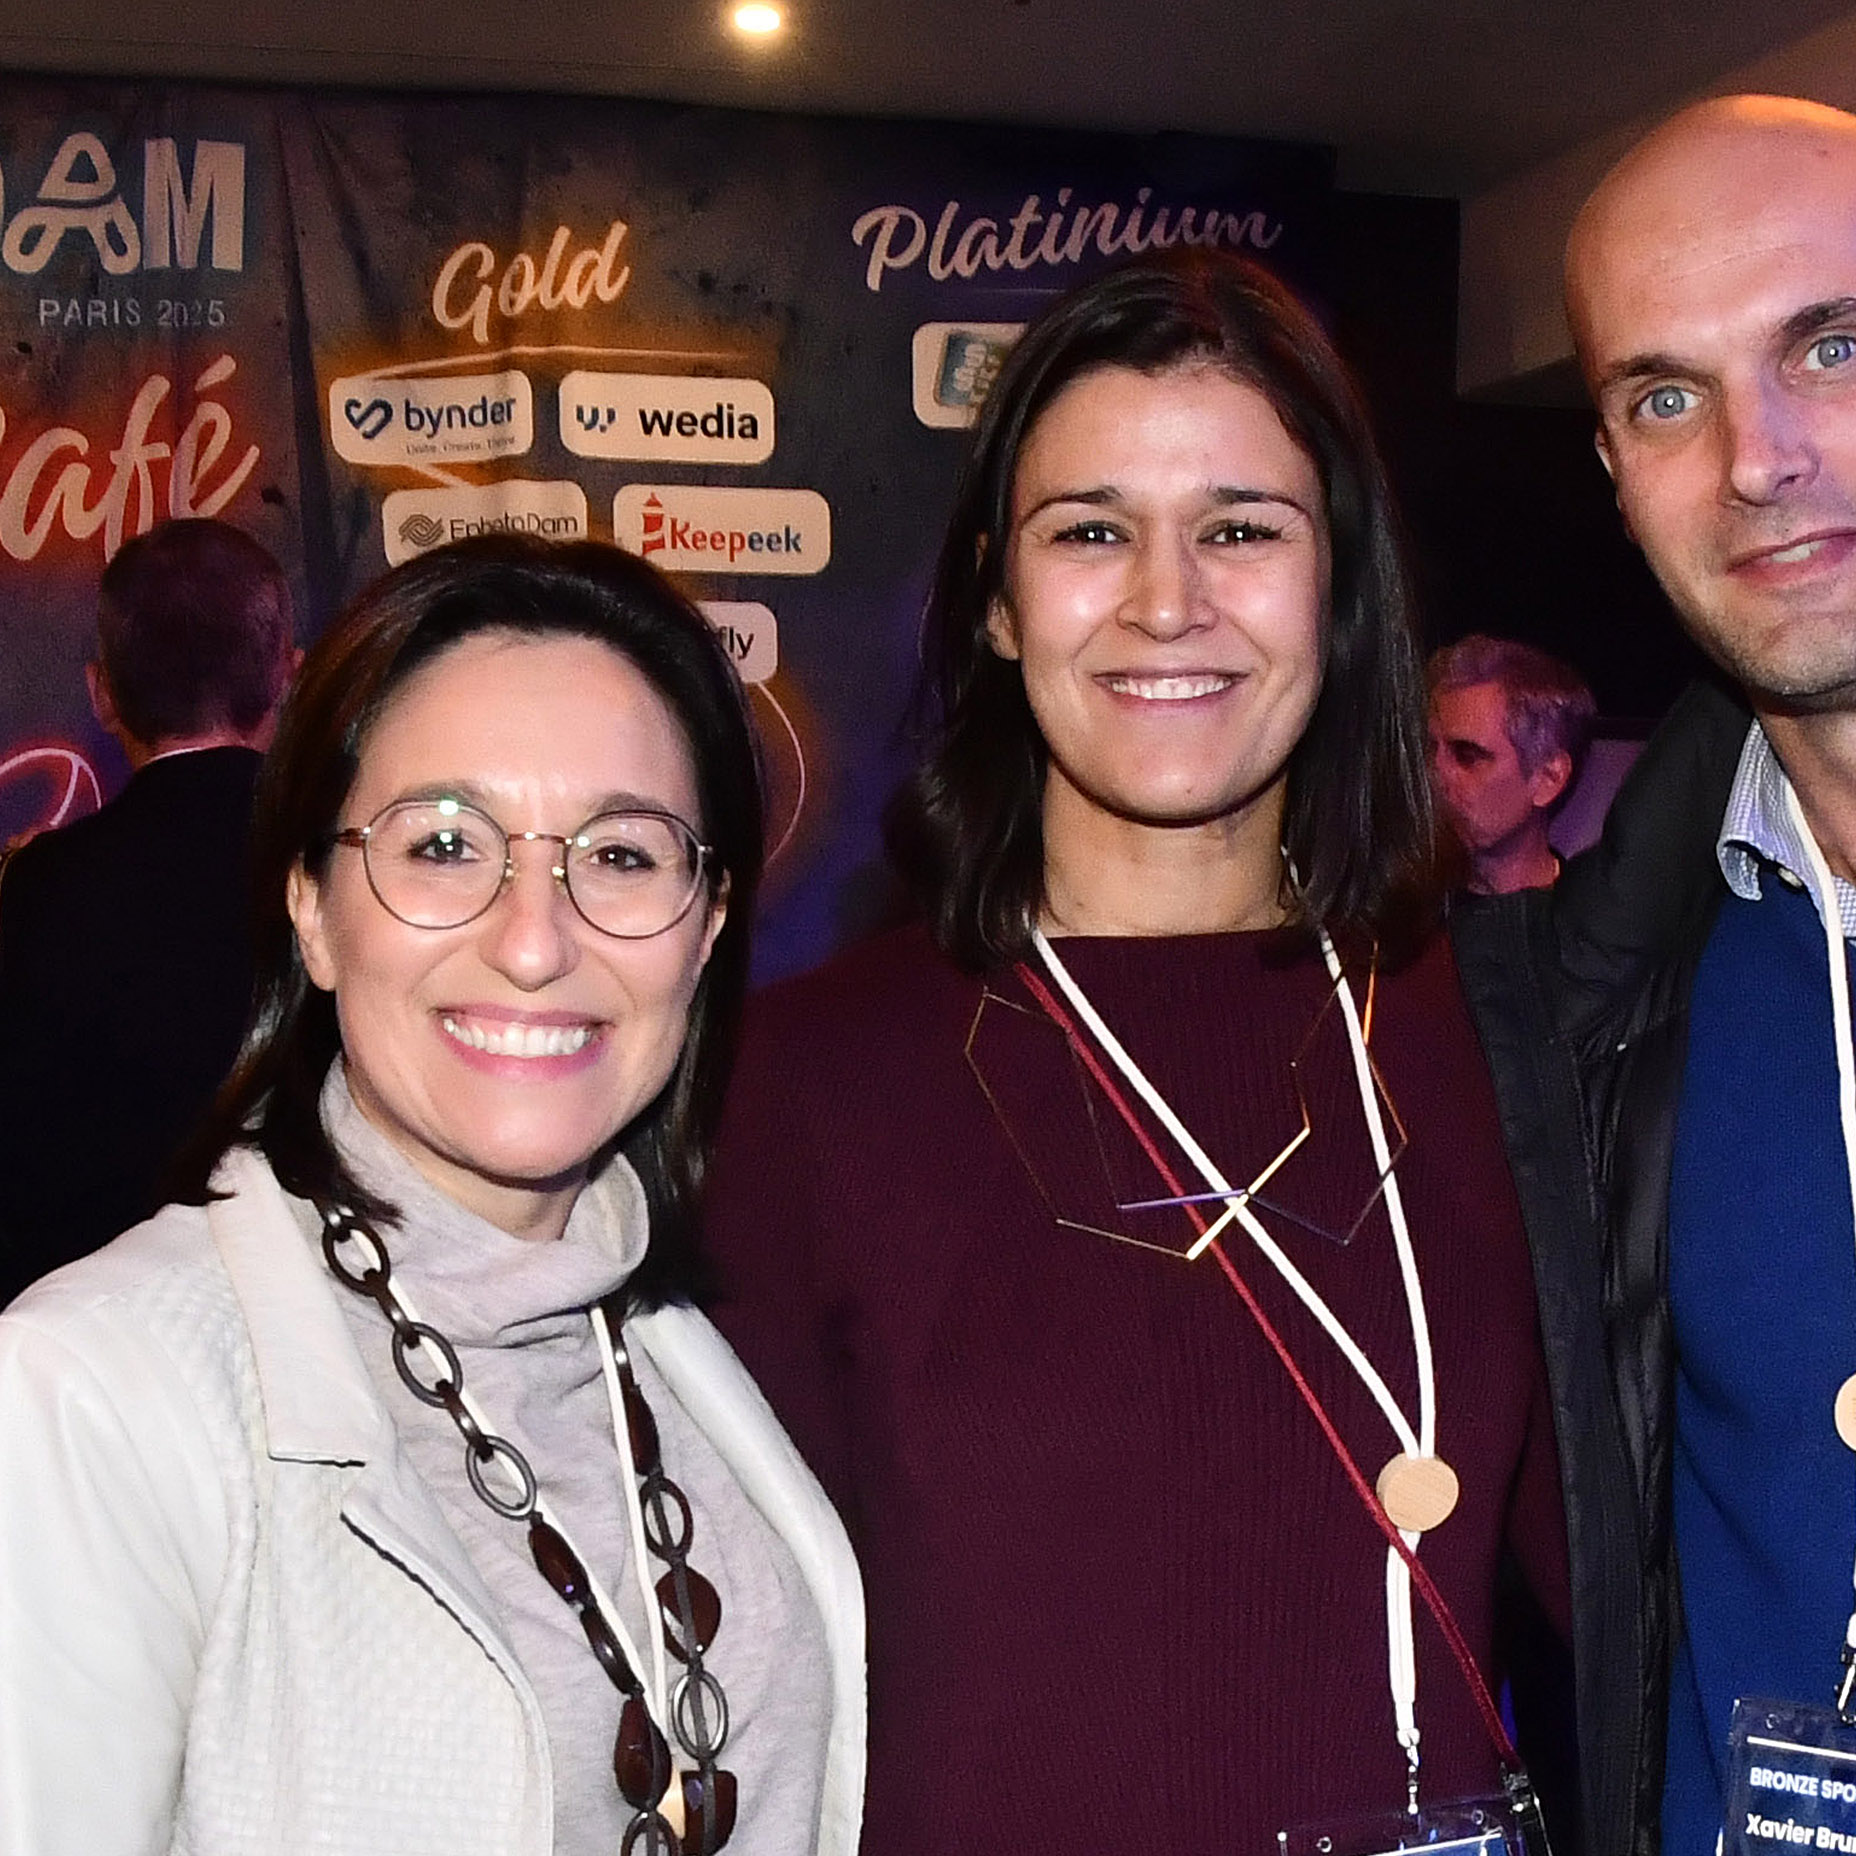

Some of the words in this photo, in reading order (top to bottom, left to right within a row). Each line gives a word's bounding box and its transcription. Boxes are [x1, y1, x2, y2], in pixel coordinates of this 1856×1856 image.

[851, 187, 1283, 292] Platinium
[433, 220, 629, 343] Gold
[39, 299, 142, 328] PARIS
[404, 395, 516, 438] bynder
[638, 402, 759, 440] wedia
[670, 517, 802, 562] Keepeek
[719, 626, 754, 661] fly
[1750, 1766, 1819, 1798] BRONZE
[1745, 1813, 1816, 1847] Xavier
